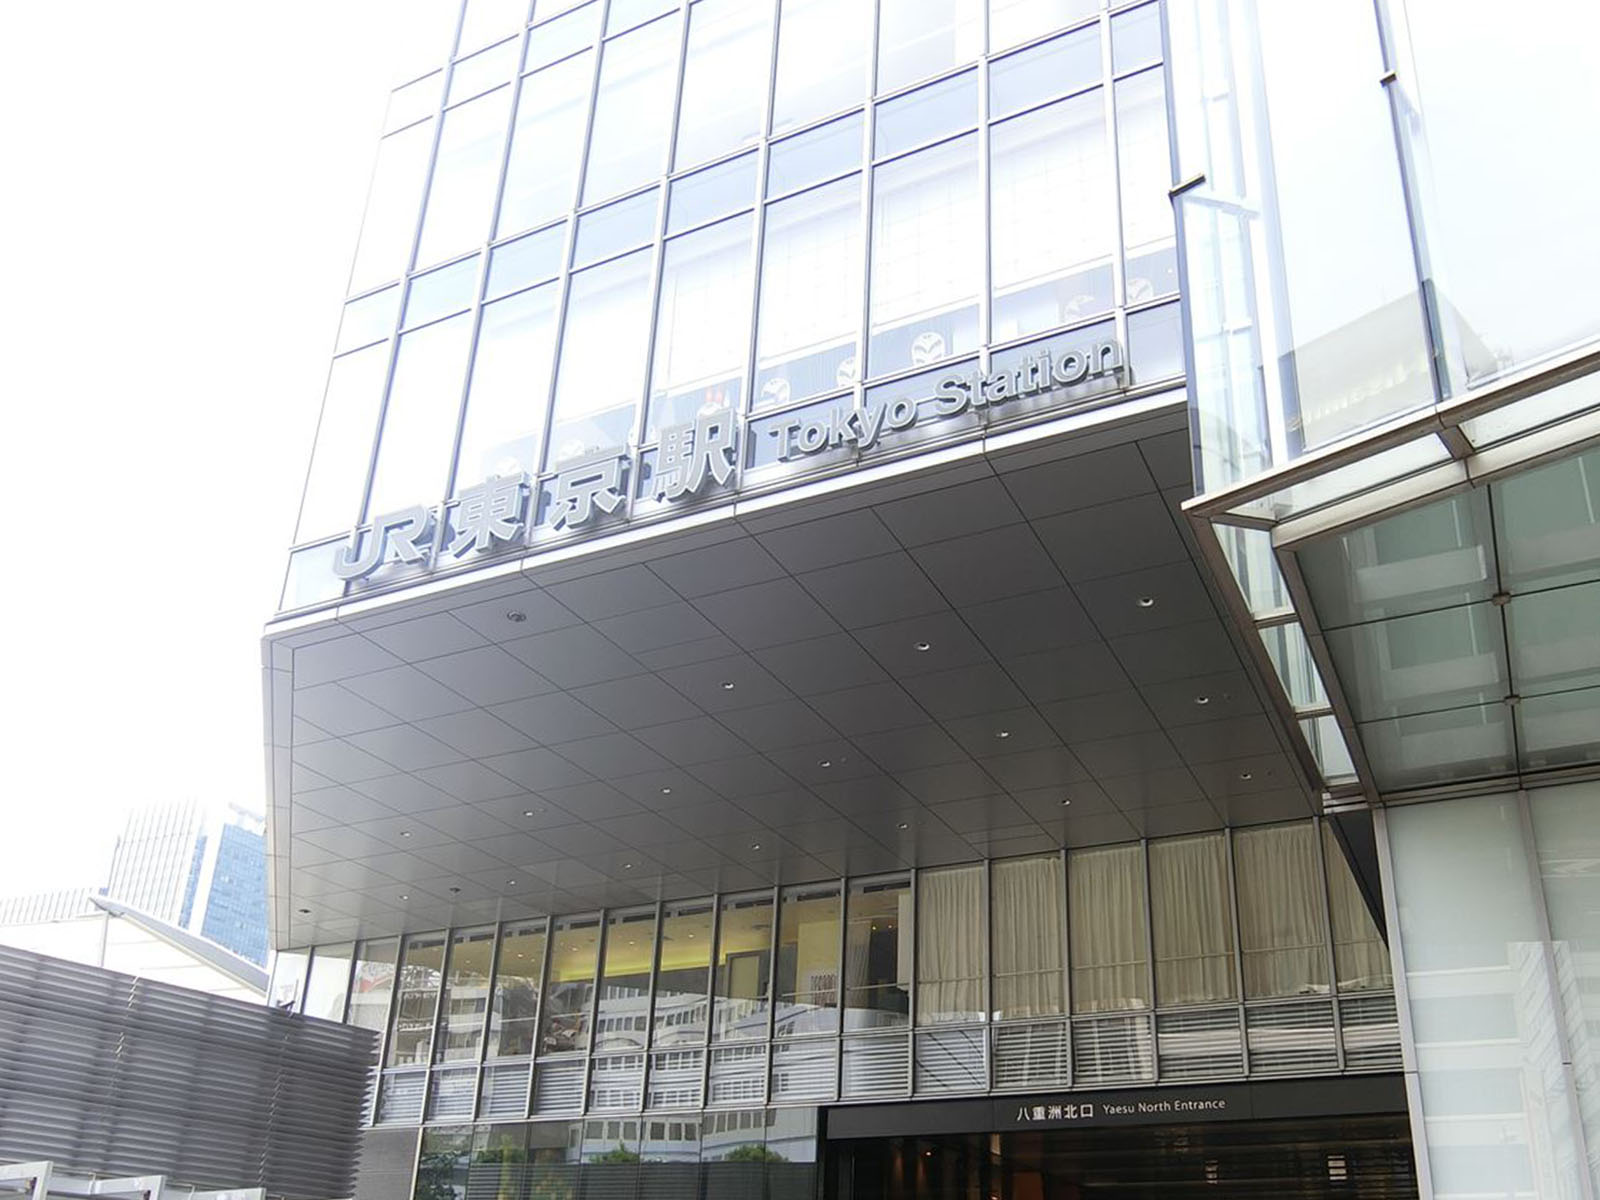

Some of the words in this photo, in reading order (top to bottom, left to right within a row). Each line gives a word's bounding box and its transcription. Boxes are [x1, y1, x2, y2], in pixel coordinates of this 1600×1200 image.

[769, 391, 918, 462] Tokyo
[933, 340, 1125, 418] Station
[1017, 1104, 1094, 1121] 八重洲北口
[1103, 1103, 1135, 1115] Yaesu
[1138, 1101, 1171, 1112] North
[1174, 1099, 1226, 1111] Entrance
